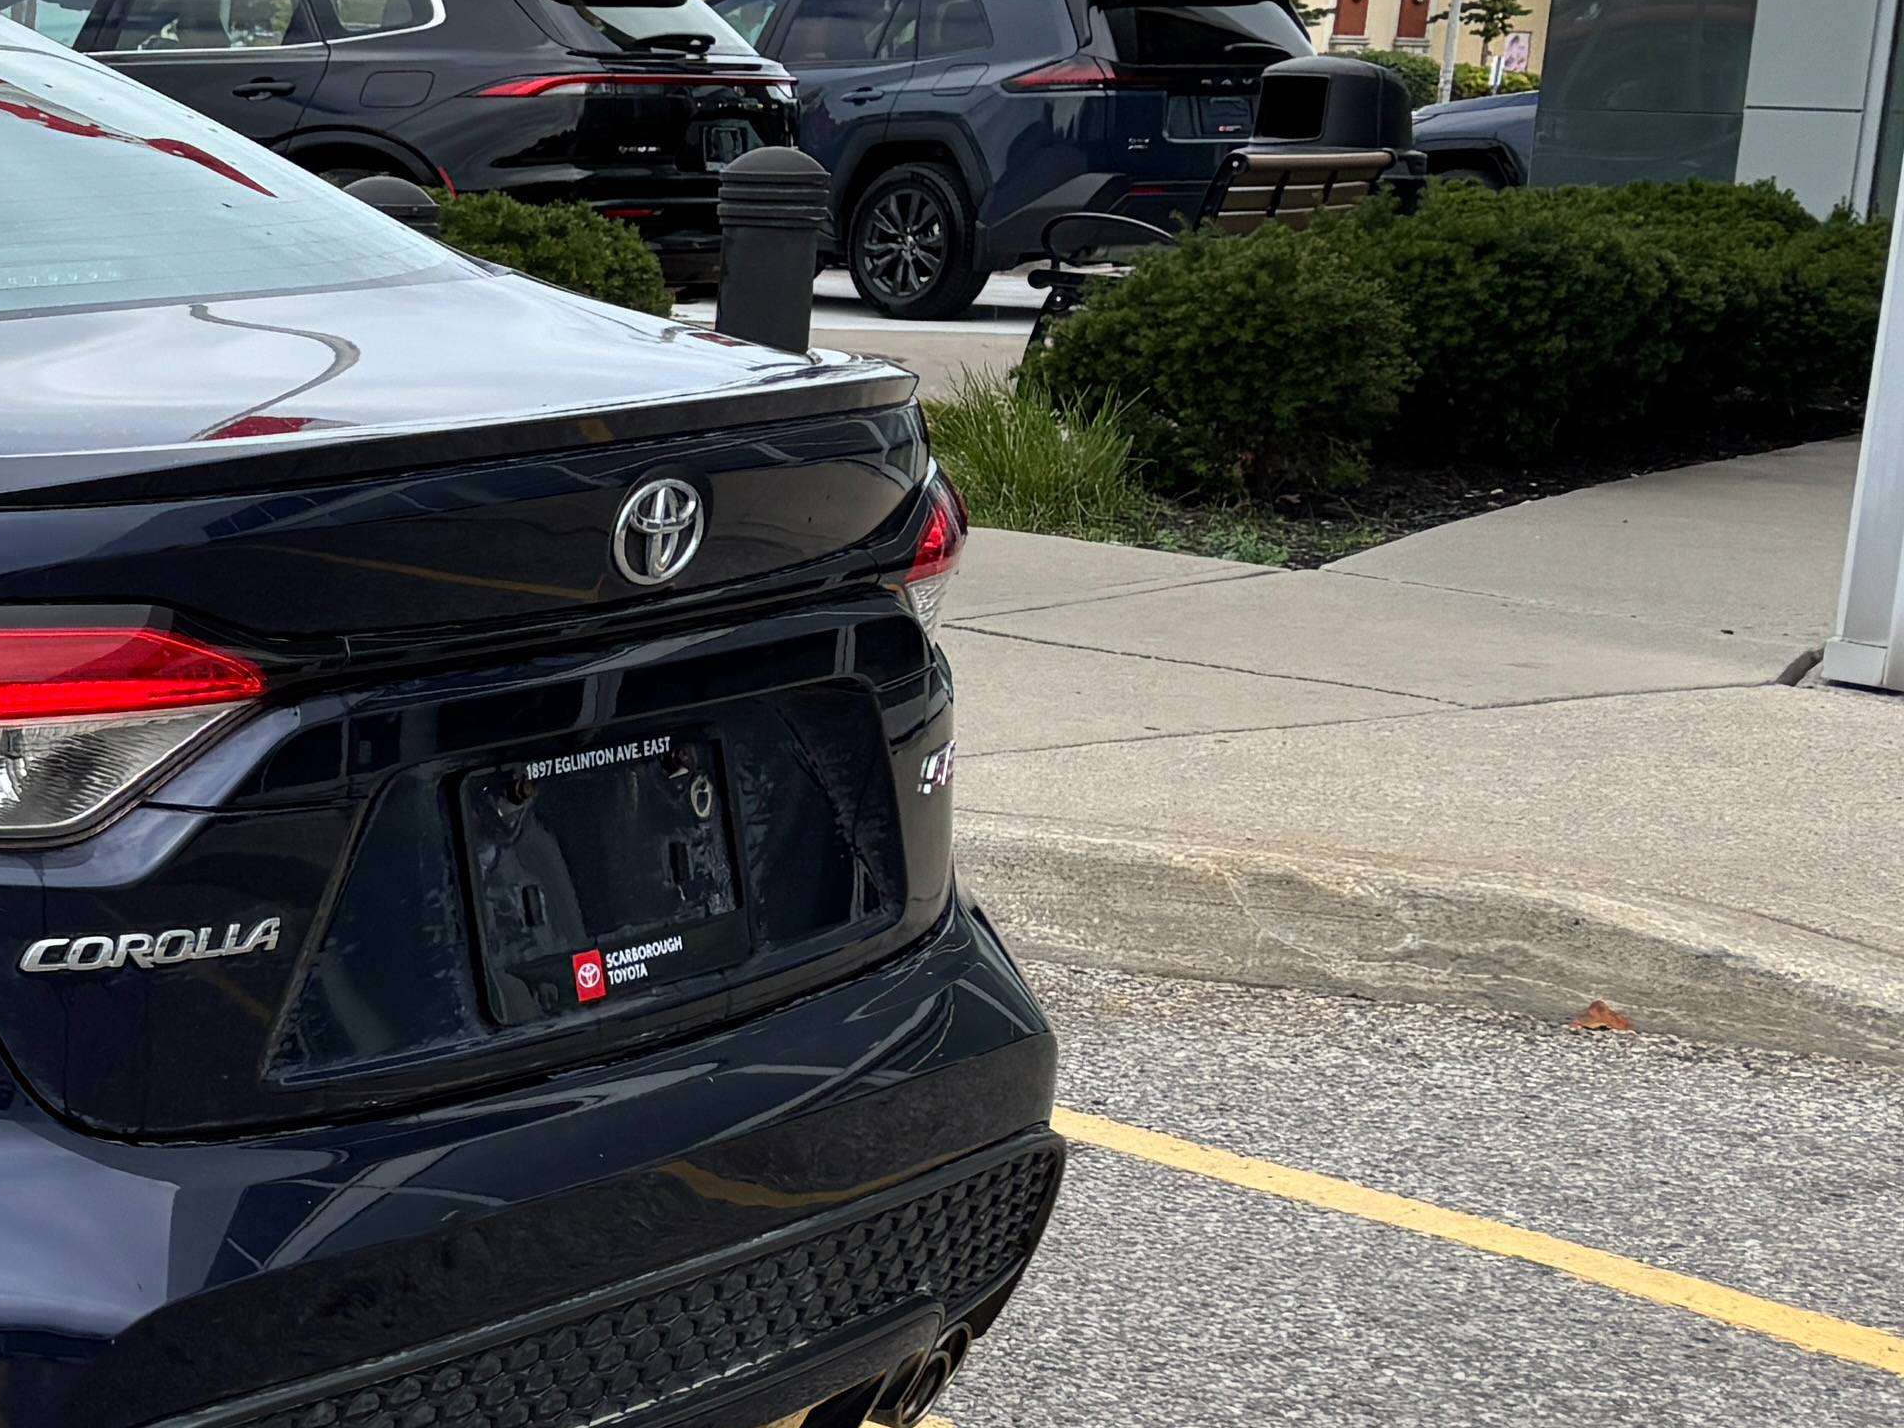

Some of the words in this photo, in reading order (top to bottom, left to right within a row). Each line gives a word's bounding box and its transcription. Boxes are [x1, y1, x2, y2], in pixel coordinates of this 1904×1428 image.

[526, 760, 553, 780] 1897
[555, 747, 614, 774] EGLINTON
[616, 742, 642, 762] AVE.
[643, 736, 671, 756] EAST
[19, 916, 281, 972] COROLLA
[605, 935, 683, 968] SCARBOROUGH
[607, 963, 648, 985] TOYOTA
